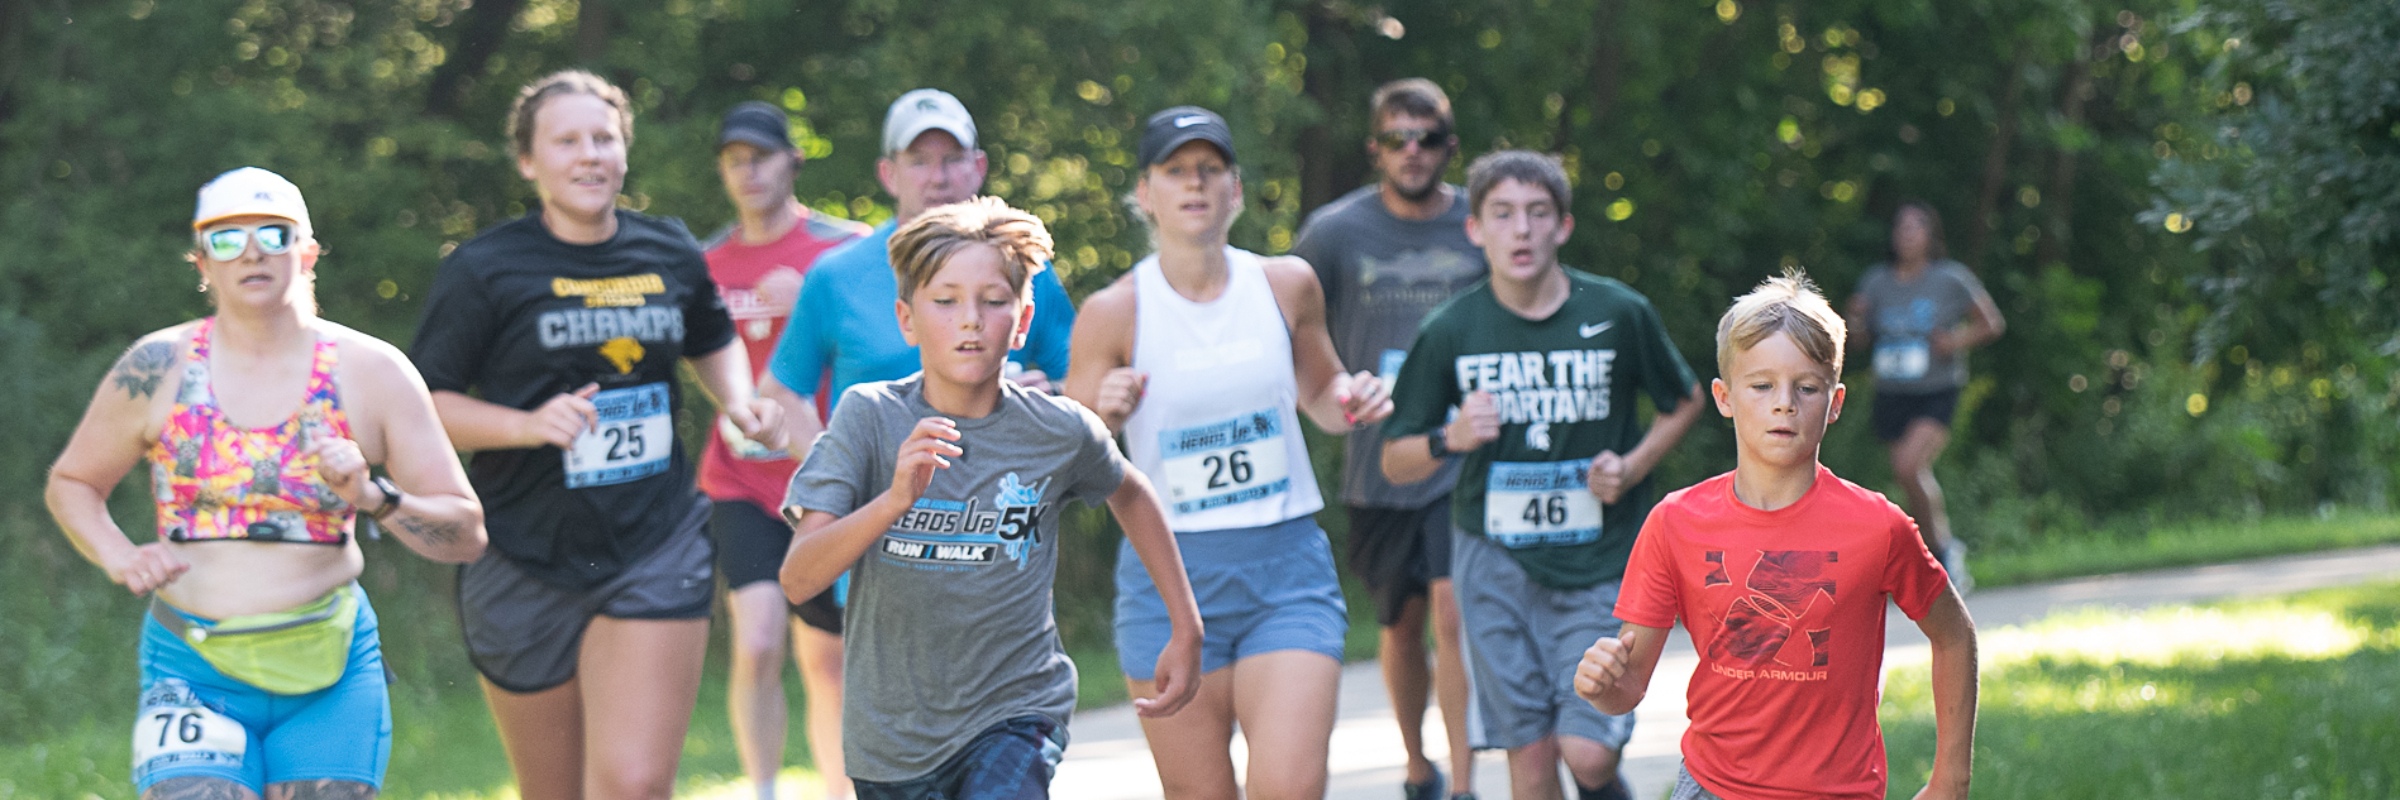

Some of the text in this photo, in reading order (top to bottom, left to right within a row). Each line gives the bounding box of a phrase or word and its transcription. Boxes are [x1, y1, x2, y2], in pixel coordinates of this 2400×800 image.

[1455, 349, 1617, 393] FEAR THE
[604, 424, 644, 462] 25
[1203, 450, 1253, 490] 26
[999, 503, 1048, 544] 5K
[1522, 496, 1566, 526] 46
[887, 539, 924, 558] RUN
[935, 545, 987, 562] WALK
[1711, 663, 1827, 681] UNDER ARMOUR
[155, 713, 202, 747] 76
